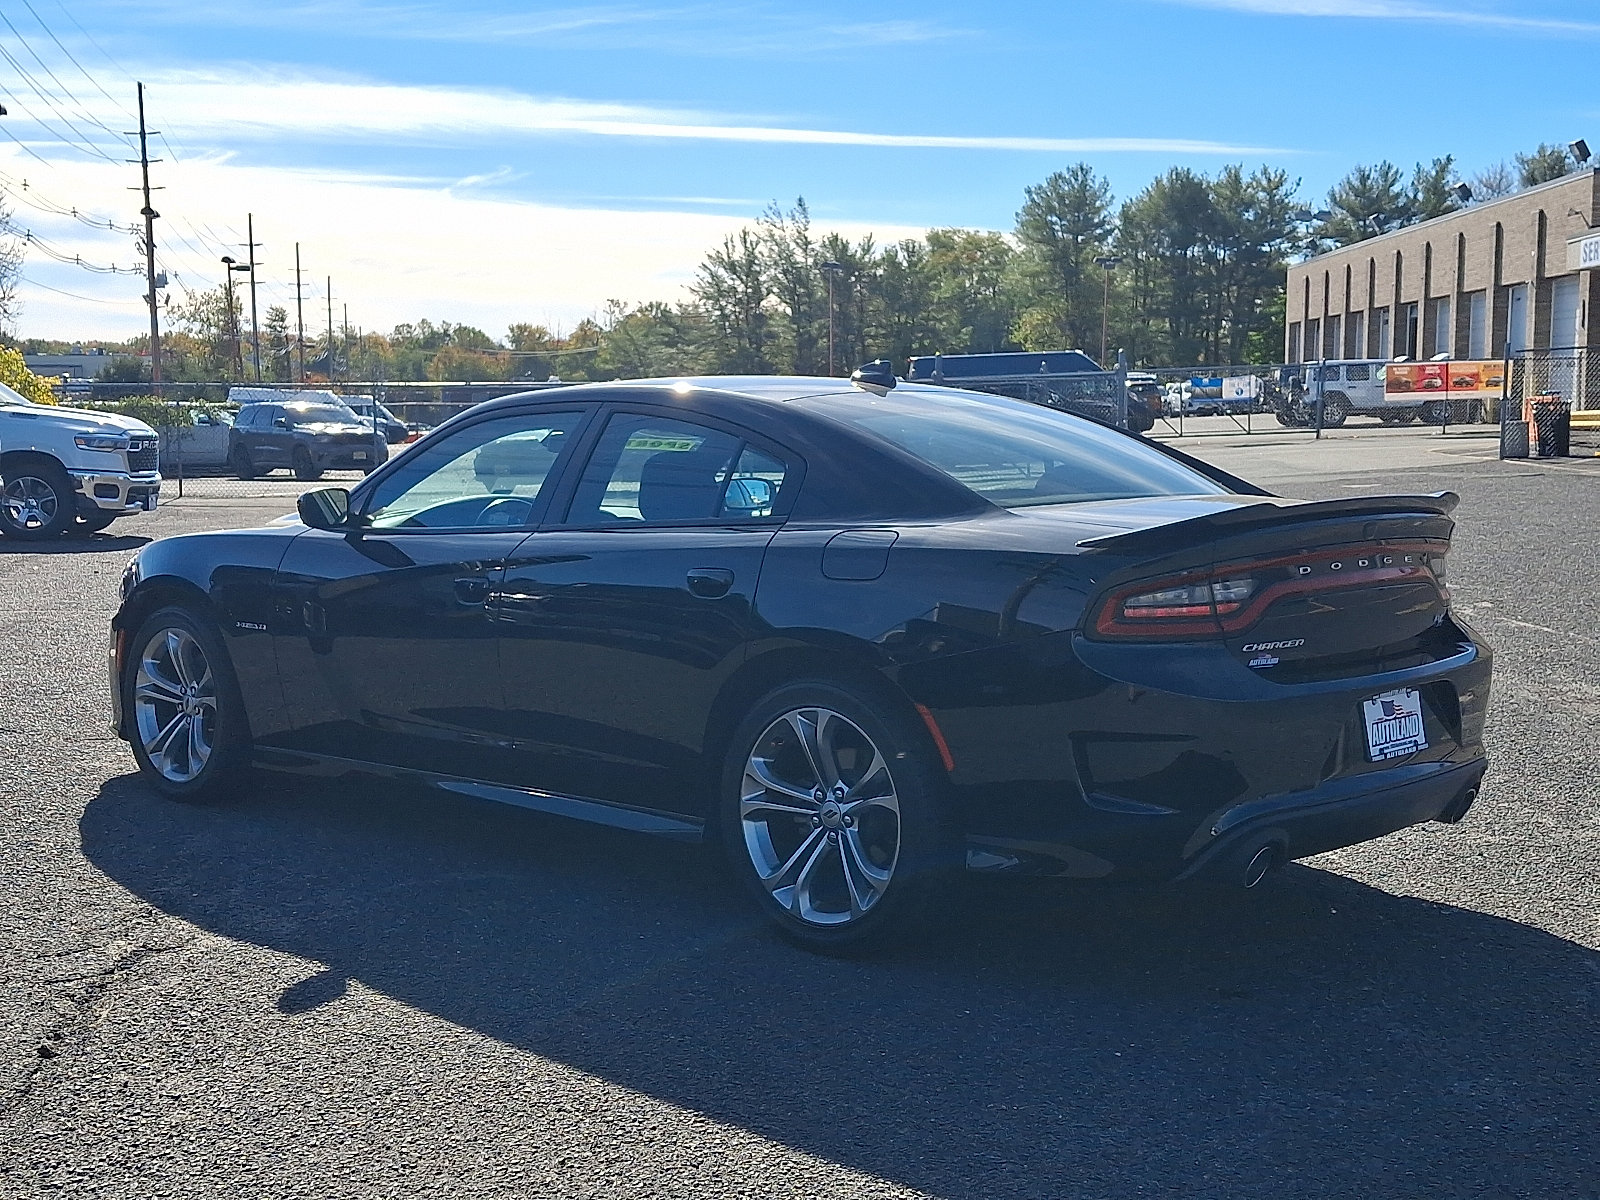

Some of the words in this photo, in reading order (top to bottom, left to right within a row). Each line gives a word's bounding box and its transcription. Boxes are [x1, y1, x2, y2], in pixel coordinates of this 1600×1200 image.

[1299, 555, 1413, 575] DODGE
[1242, 638, 1305, 652] CHARGER
[1372, 715, 1419, 747] AUTOLAND
[1386, 746, 1417, 759] AUTOLAND
